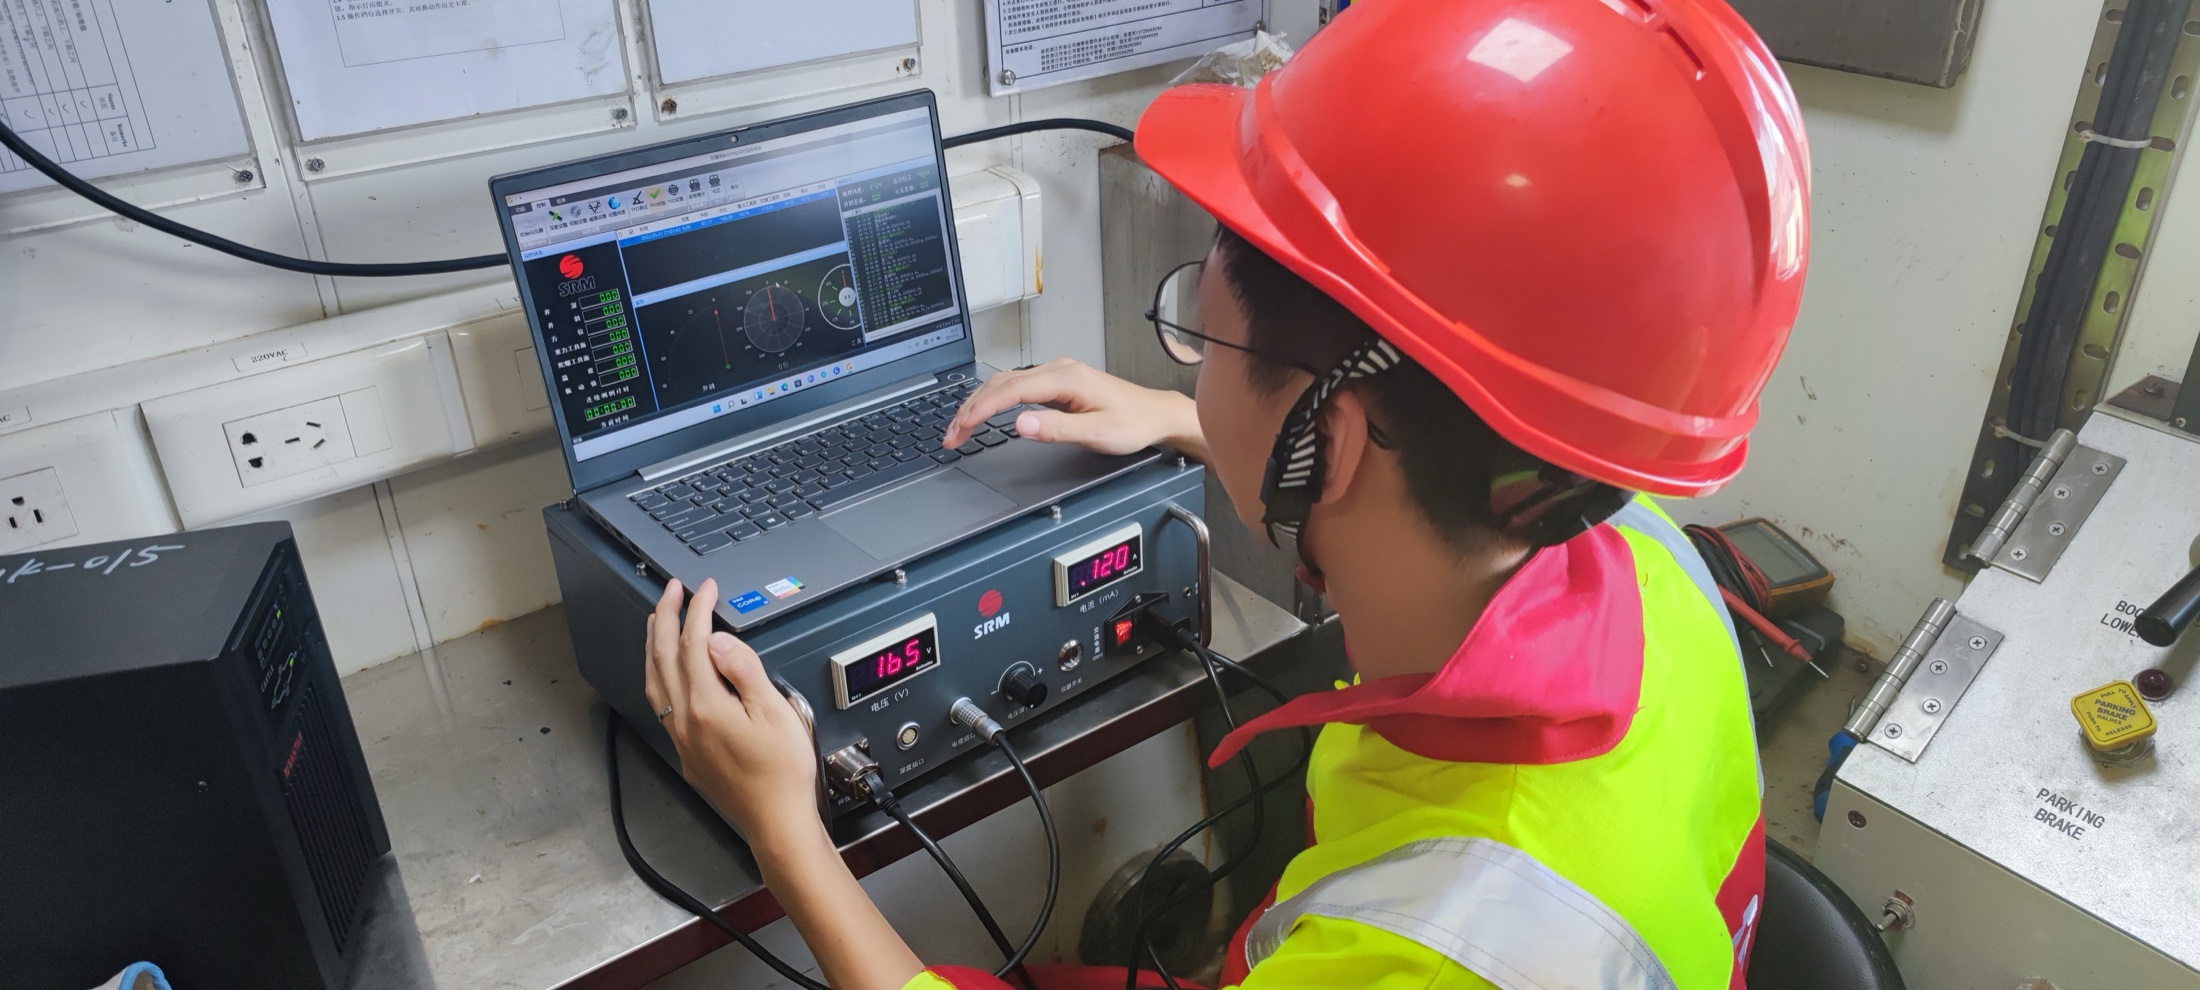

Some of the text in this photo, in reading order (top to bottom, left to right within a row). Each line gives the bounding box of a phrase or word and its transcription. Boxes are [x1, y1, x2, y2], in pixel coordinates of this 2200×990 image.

[107, 93, 116, 110] Status
[117, 123, 128, 147] Remarks
[558, 276, 597, 297] SRM
[250, 349, 289, 364] 220VAC
[554, 342, 586, 356] 重力工具面
[586, 398, 634, 419] 00:00:00
[2115, 600, 2145, 618] BOO
[974, 611, 1010, 640] SRM
[2100, 613, 2141, 638] LOWE
[926, 646, 932, 654] V
[261, 663, 275, 693] CASTLE
[1060, 677, 1083, 693] 仪器开关
[2094, 699, 2136, 716] PARKING
[2101, 690, 2116, 698] PULL
[2124, 694, 2137, 709] APPLY
[1008, 706, 1029, 719] 电压调
[2086, 711, 2102, 732] PUSH TO
[2096, 714, 2122, 725] HALDEX
[2097, 707, 2128, 721] BRAKE
[2105, 724, 2133, 737] RELEASE
[899, 757, 925, 775] 深度插口
[2036, 788, 2105, 829] PARKING
[2034, 807, 2085, 840] BRAKE
